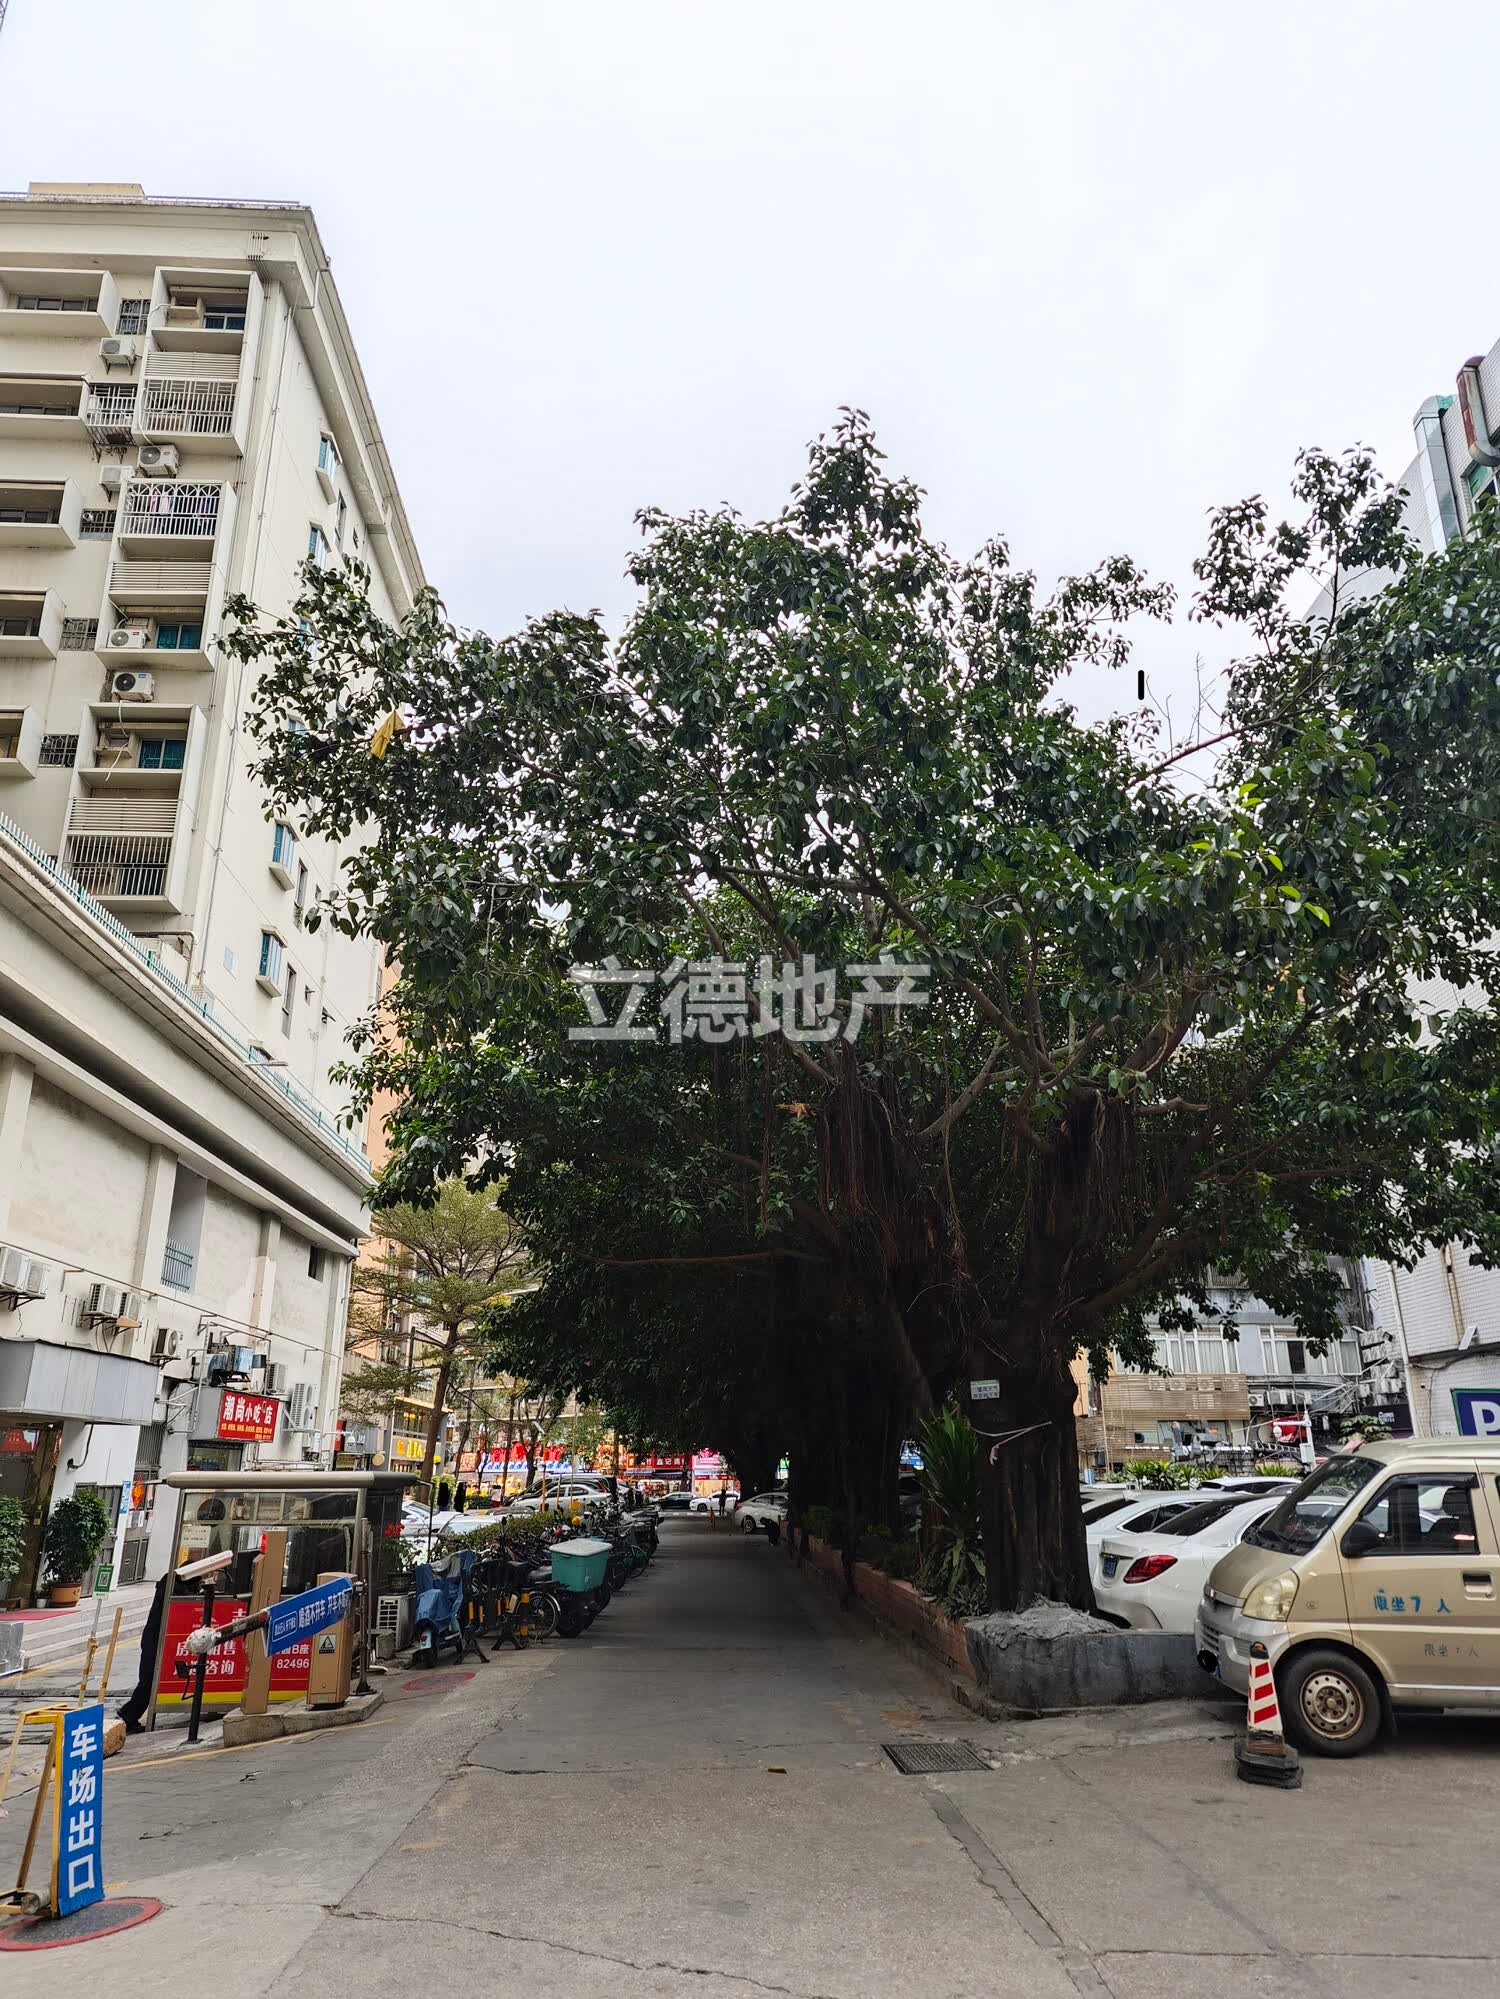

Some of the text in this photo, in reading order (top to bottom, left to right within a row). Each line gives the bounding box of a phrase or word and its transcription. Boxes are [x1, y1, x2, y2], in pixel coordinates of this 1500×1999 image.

[176, 1640, 236, 1656] 房租售
[68, 1724, 97, 1898] 车场出口
